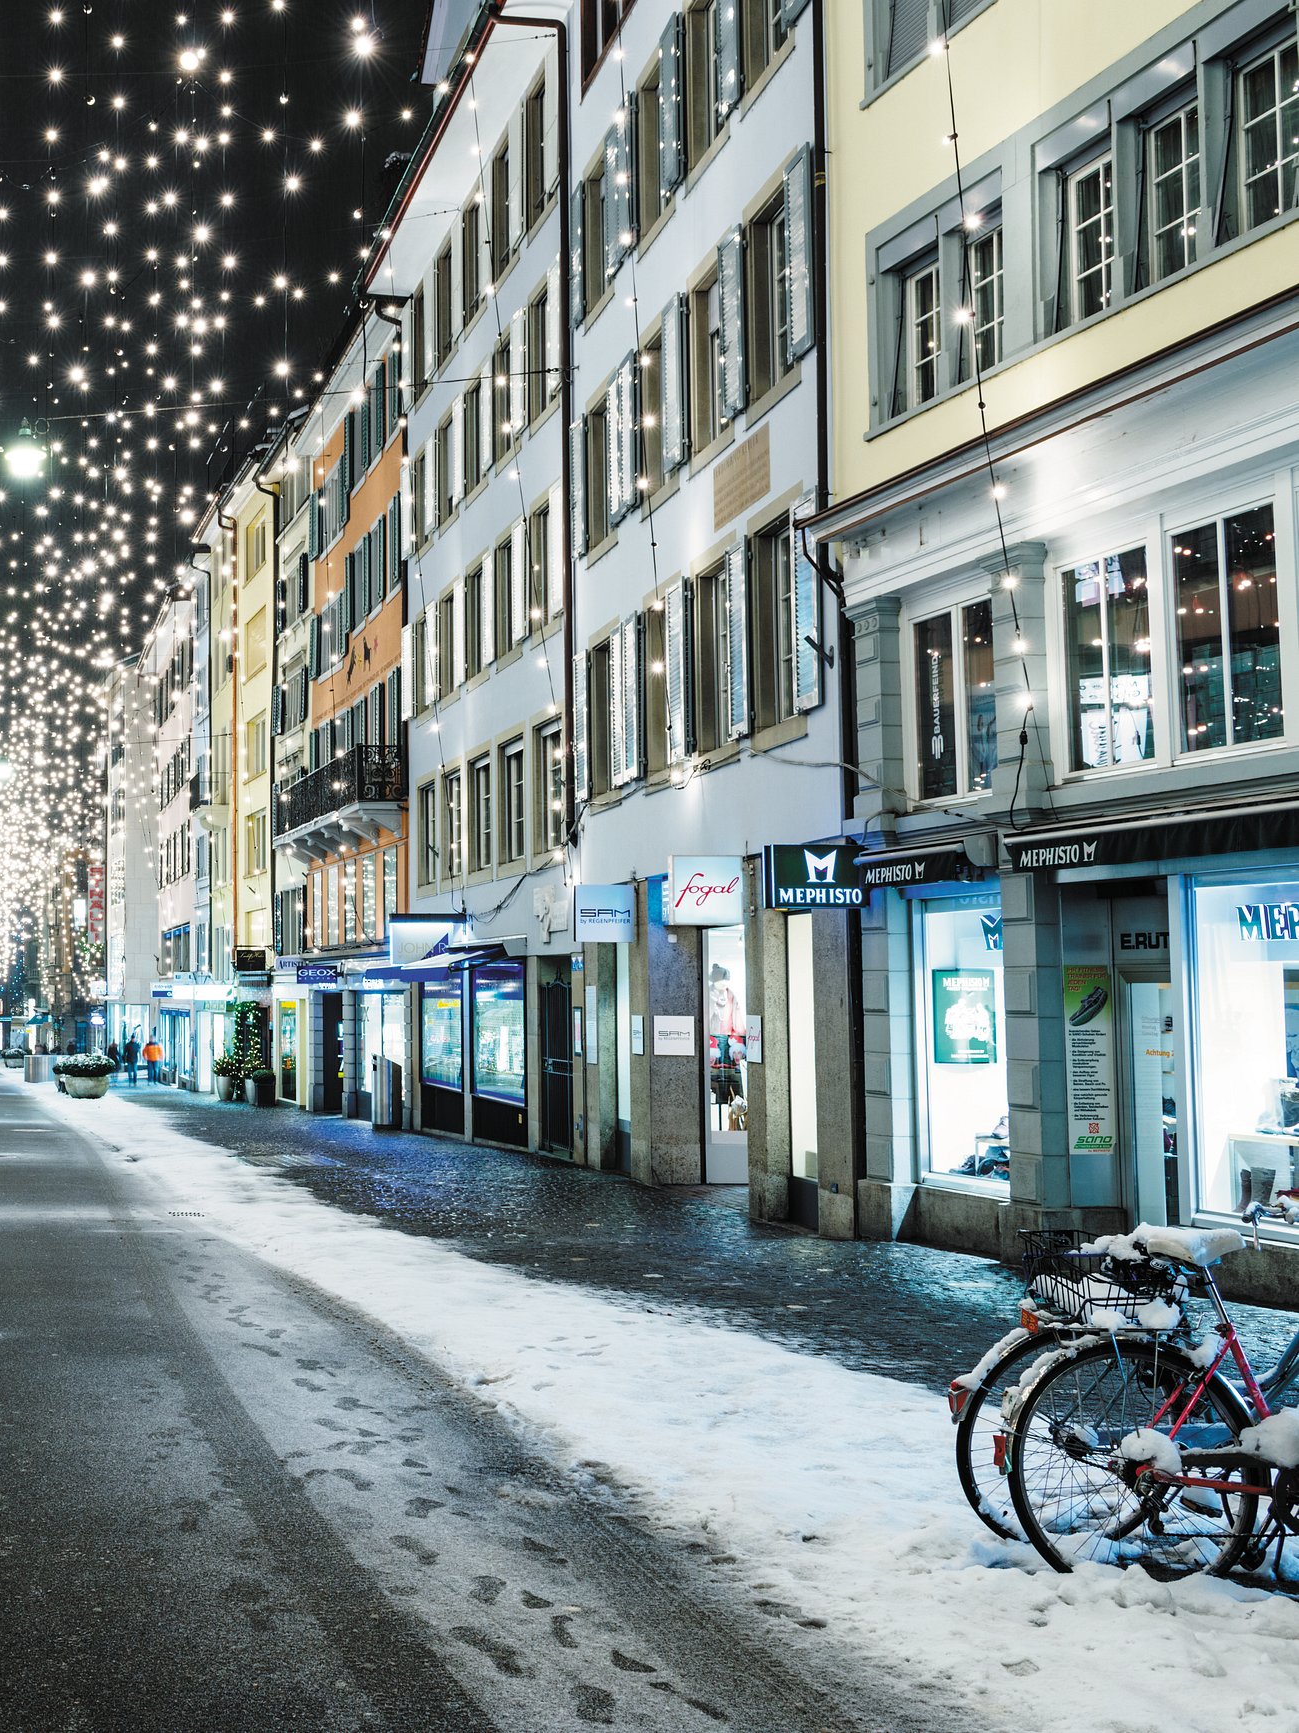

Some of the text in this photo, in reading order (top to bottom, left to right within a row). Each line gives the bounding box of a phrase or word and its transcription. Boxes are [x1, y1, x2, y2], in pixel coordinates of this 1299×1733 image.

[931, 656, 941, 735] BAUERFEIND
[1020, 844, 1080, 868] MEPHISTO
[865, 863, 912, 885] MEPHISTO
[674, 872, 740, 908] fogal
[779, 887, 863, 905] MEPHISTO
[580, 908, 631, 918] SAM
[398, 942, 434, 955] JOHN
[298, 968, 336, 977] GEOX
[1145, 1049, 1171, 1058] Achtung
[1076, 1135, 1113, 1144] sano
